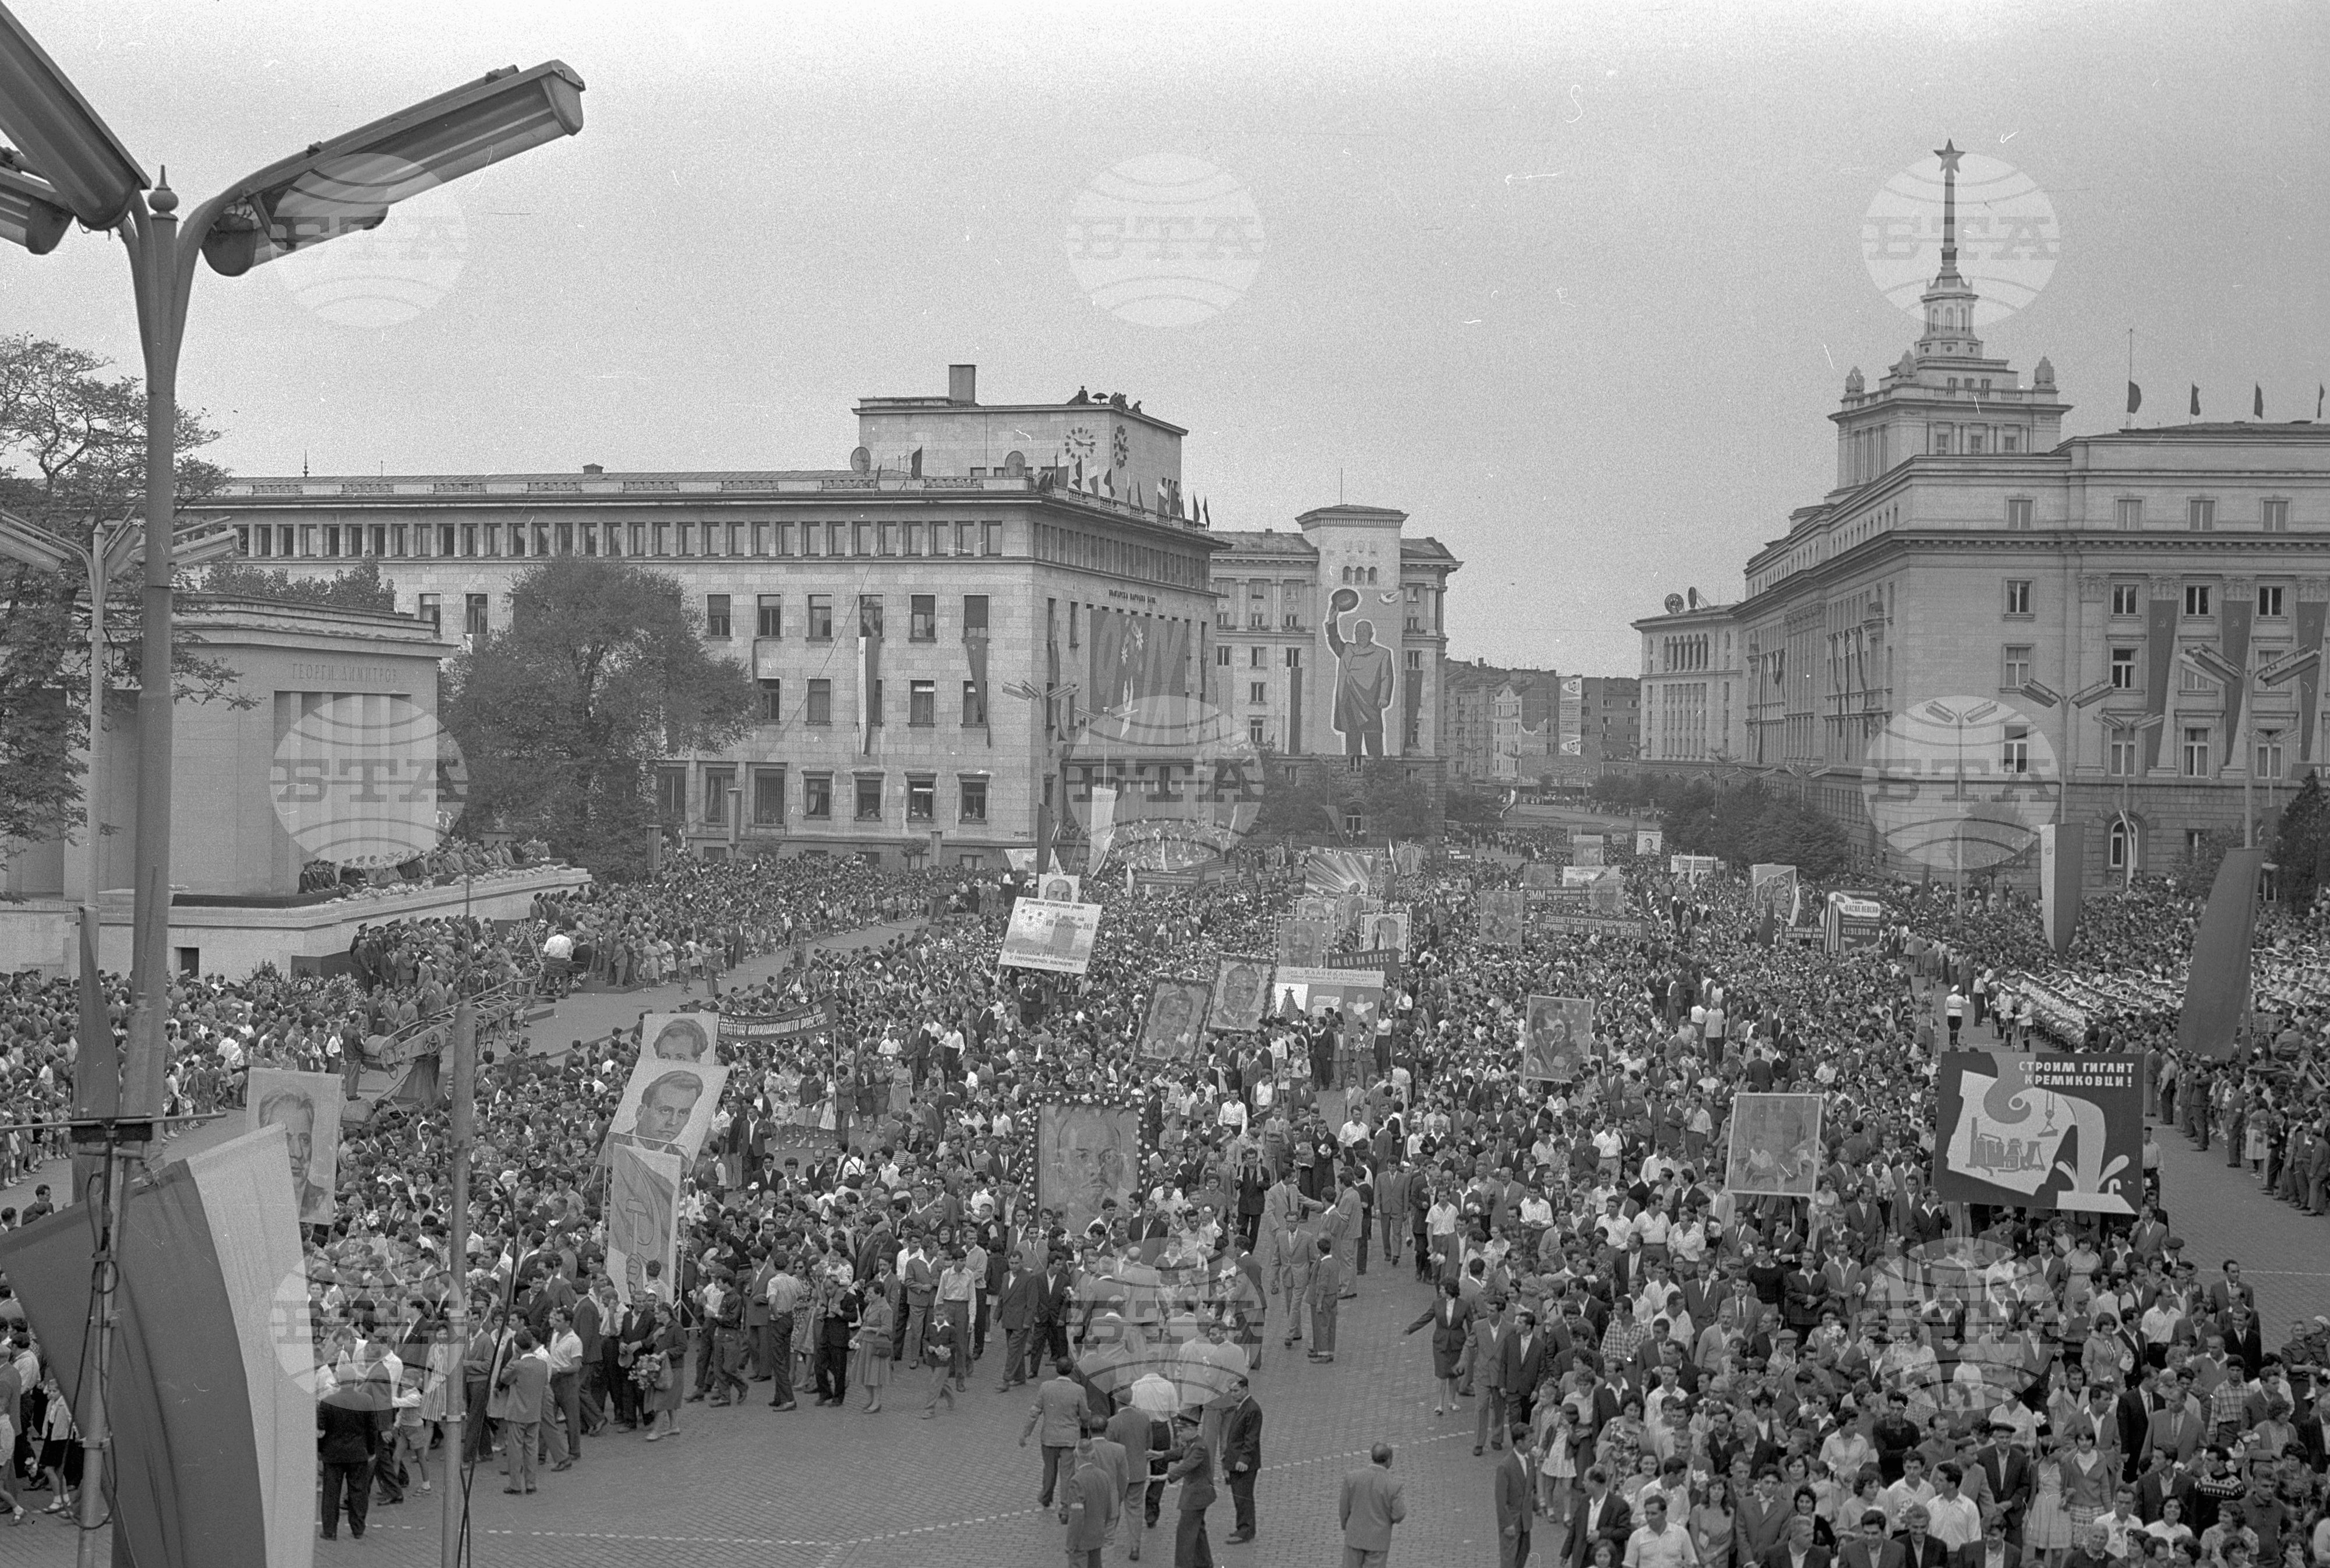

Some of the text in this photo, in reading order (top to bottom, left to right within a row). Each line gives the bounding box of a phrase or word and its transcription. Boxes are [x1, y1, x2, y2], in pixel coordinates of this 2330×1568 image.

[292, 663, 398, 683] ГЕОРГИ ДИМИТРОВ
[1526, 889, 1545, 900] ЗММ
[1540, 923, 1569, 931] ПРИВЕТ
[1606, 927, 1616, 935] НА
[1620, 928, 1641, 937] БКП
[1332, 958, 1341, 967] НА
[1343, 956, 1354, 967] ЦК
[1357, 956, 1365, 965] НА
[1368, 953, 1390, 964] КПСС
[719, 1023, 746, 1036] ПРОТИВ
[749, 1020, 799, 1035] КОЛОНИАЛНОТО
[2019, 1061, 2134, 1073] СТРОИМ ГИГАНТ
[2024, 1074, 2133, 1087] КРЕМИКОВЦИ!
